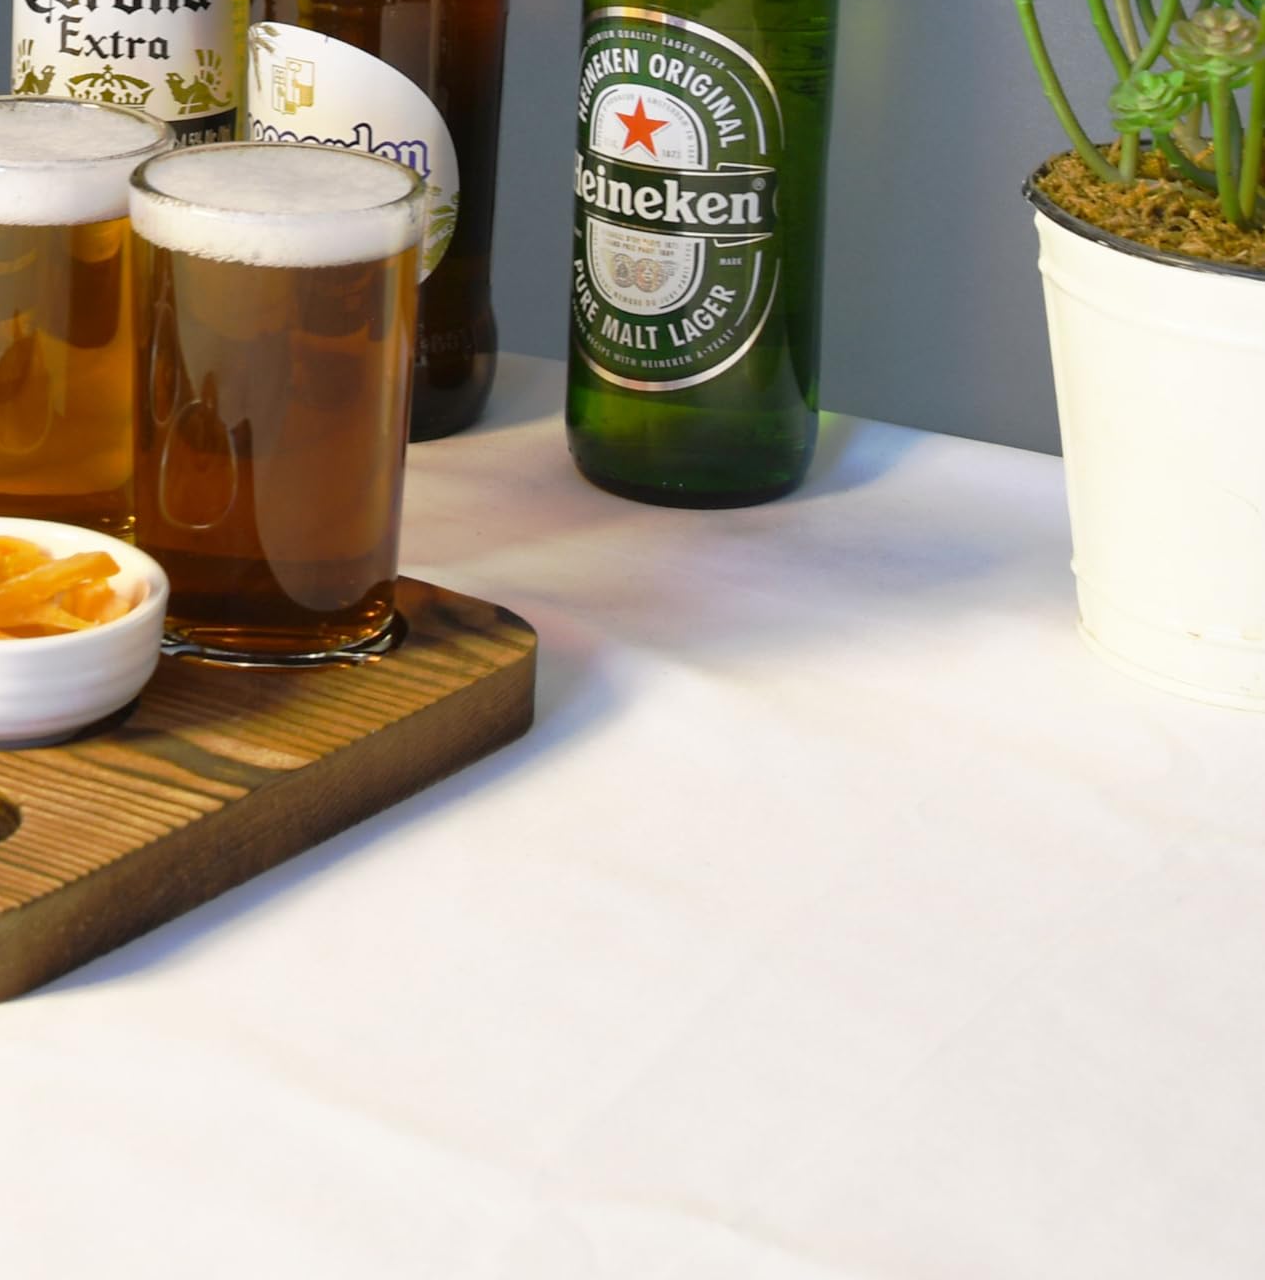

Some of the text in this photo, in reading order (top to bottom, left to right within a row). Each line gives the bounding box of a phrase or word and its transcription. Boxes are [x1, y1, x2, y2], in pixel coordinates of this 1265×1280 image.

[58, 14, 171, 60] Extra
[648, 53, 746, 149] ORIGINAL
[574, 259, 600, 322] PURE
[602, 314, 658, 350] MALT
[667, 284, 737, 347] LAGER
